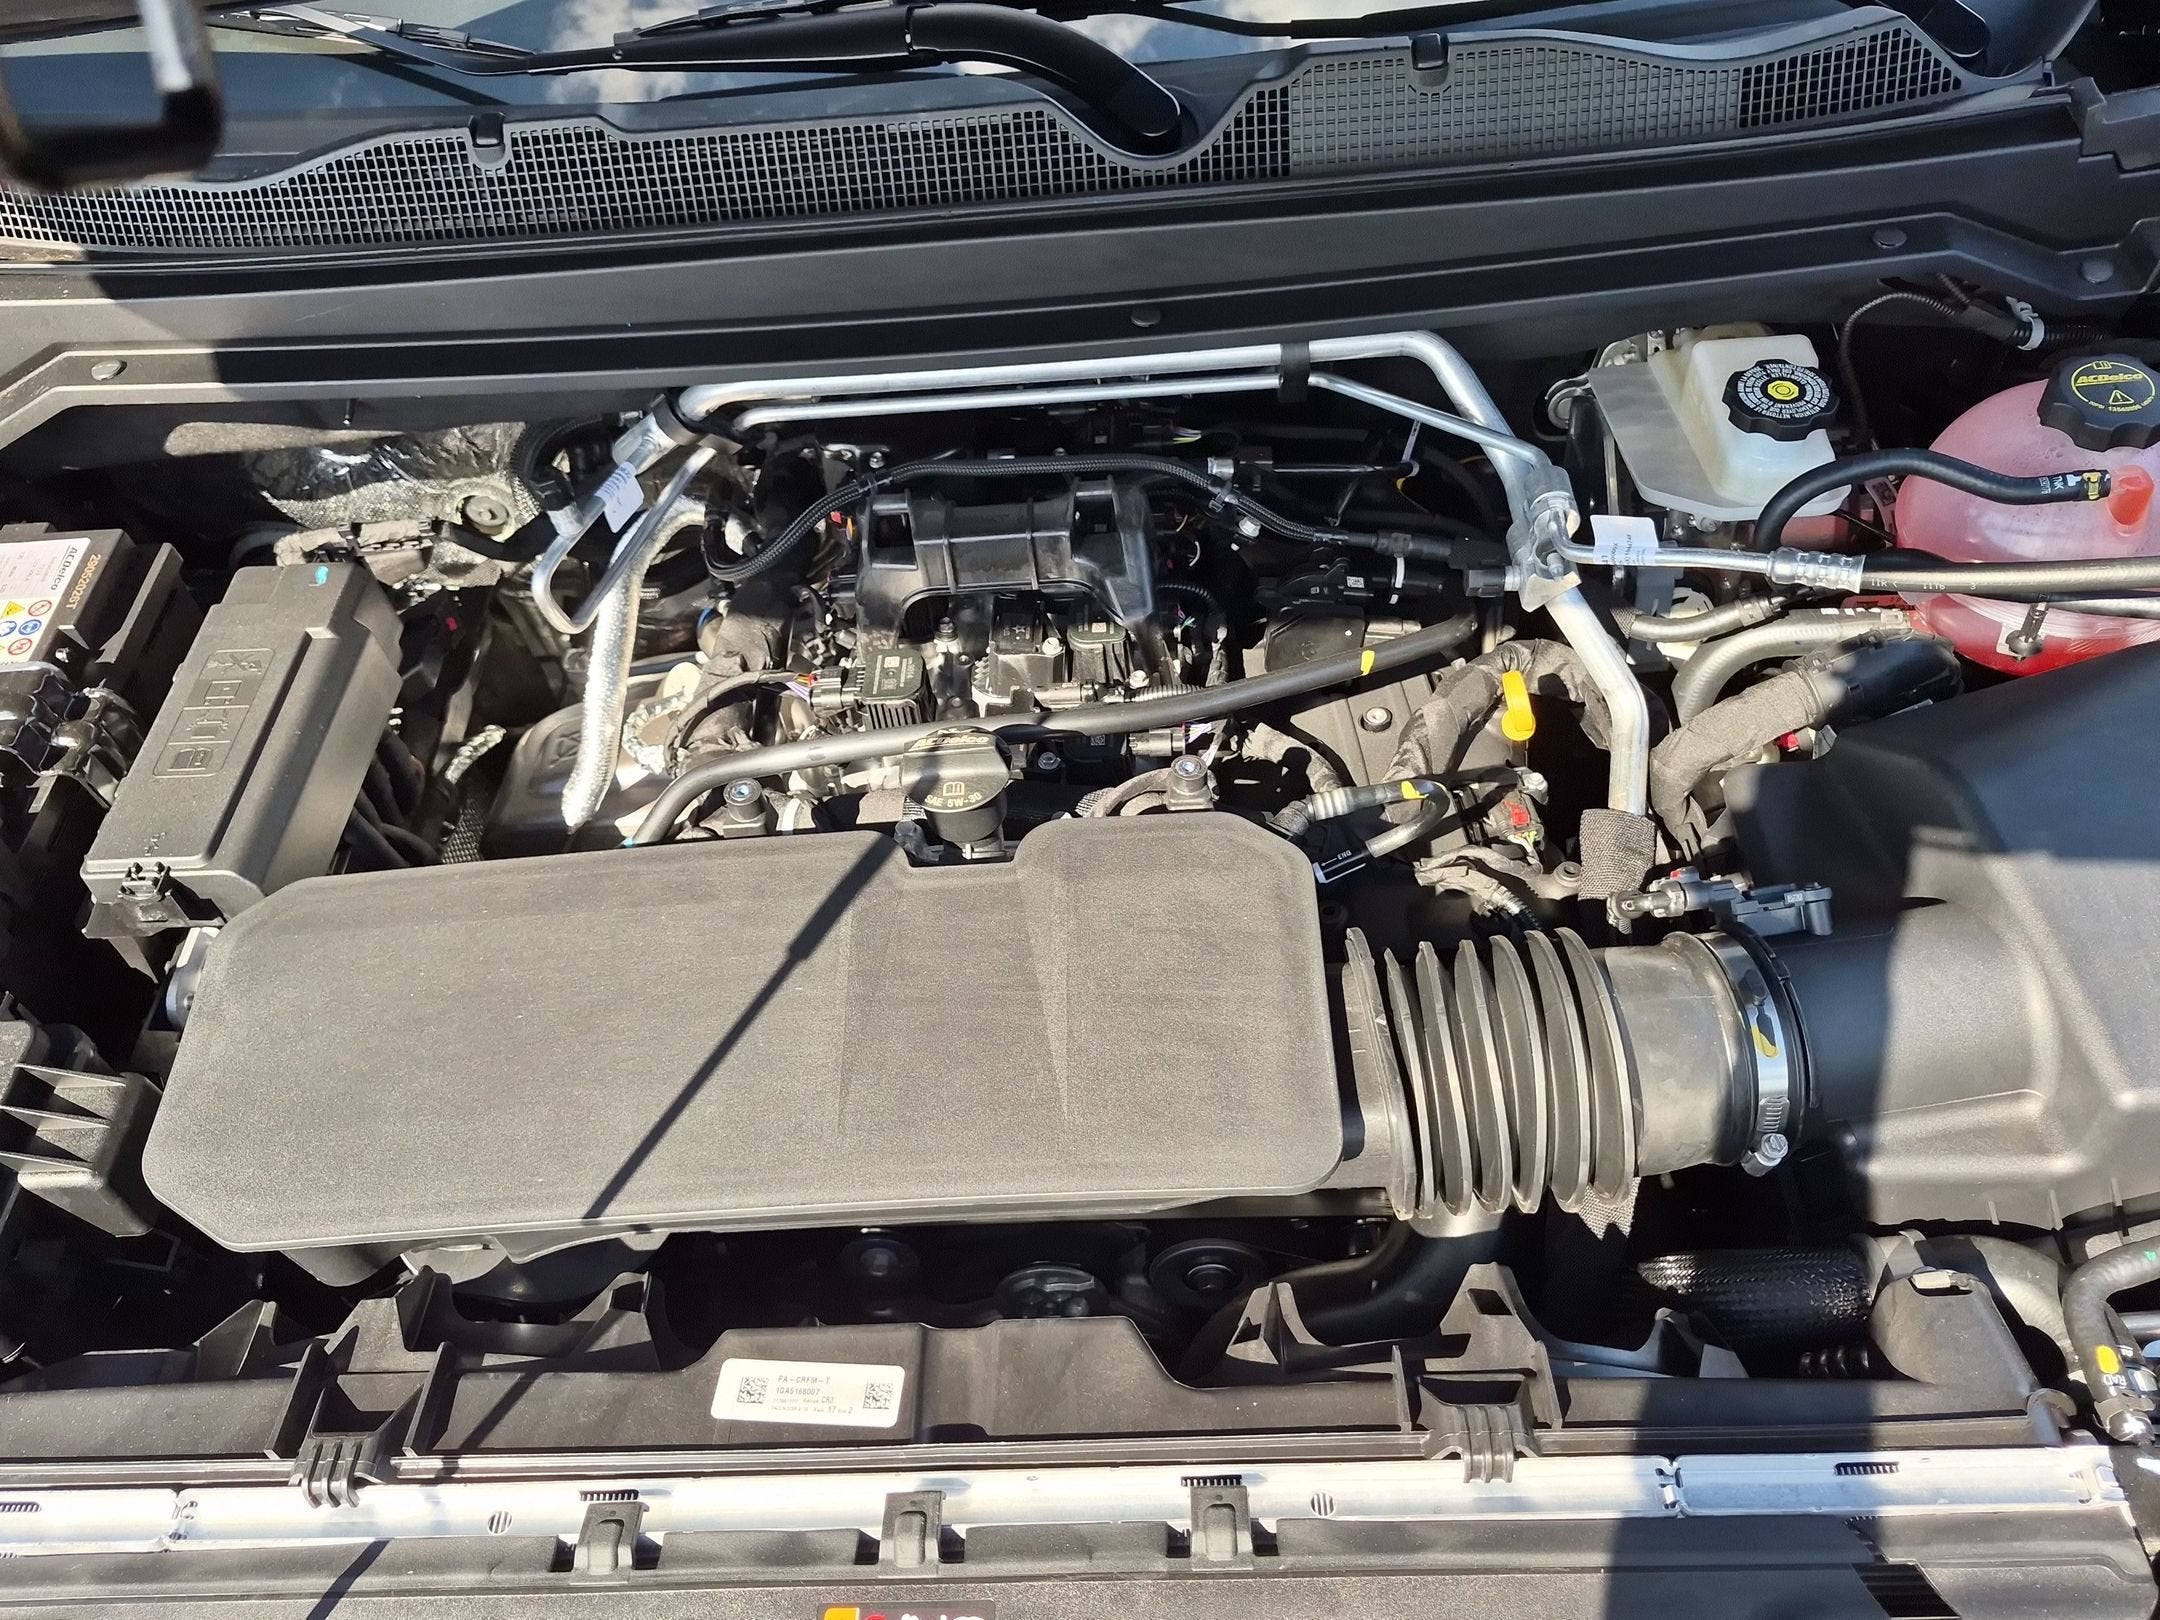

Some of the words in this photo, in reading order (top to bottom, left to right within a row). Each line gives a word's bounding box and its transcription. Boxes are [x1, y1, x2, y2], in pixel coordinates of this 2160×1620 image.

[2075, 373, 2144, 384] ACDelco
[50, 546, 78, 591] ACDelco
[66, 554, 102, 610] 29052026T
[924, 794, 944, 807] SAE
[947, 792, 983, 808] 5W-30
[2103, 1374, 2127, 1386] RAD
